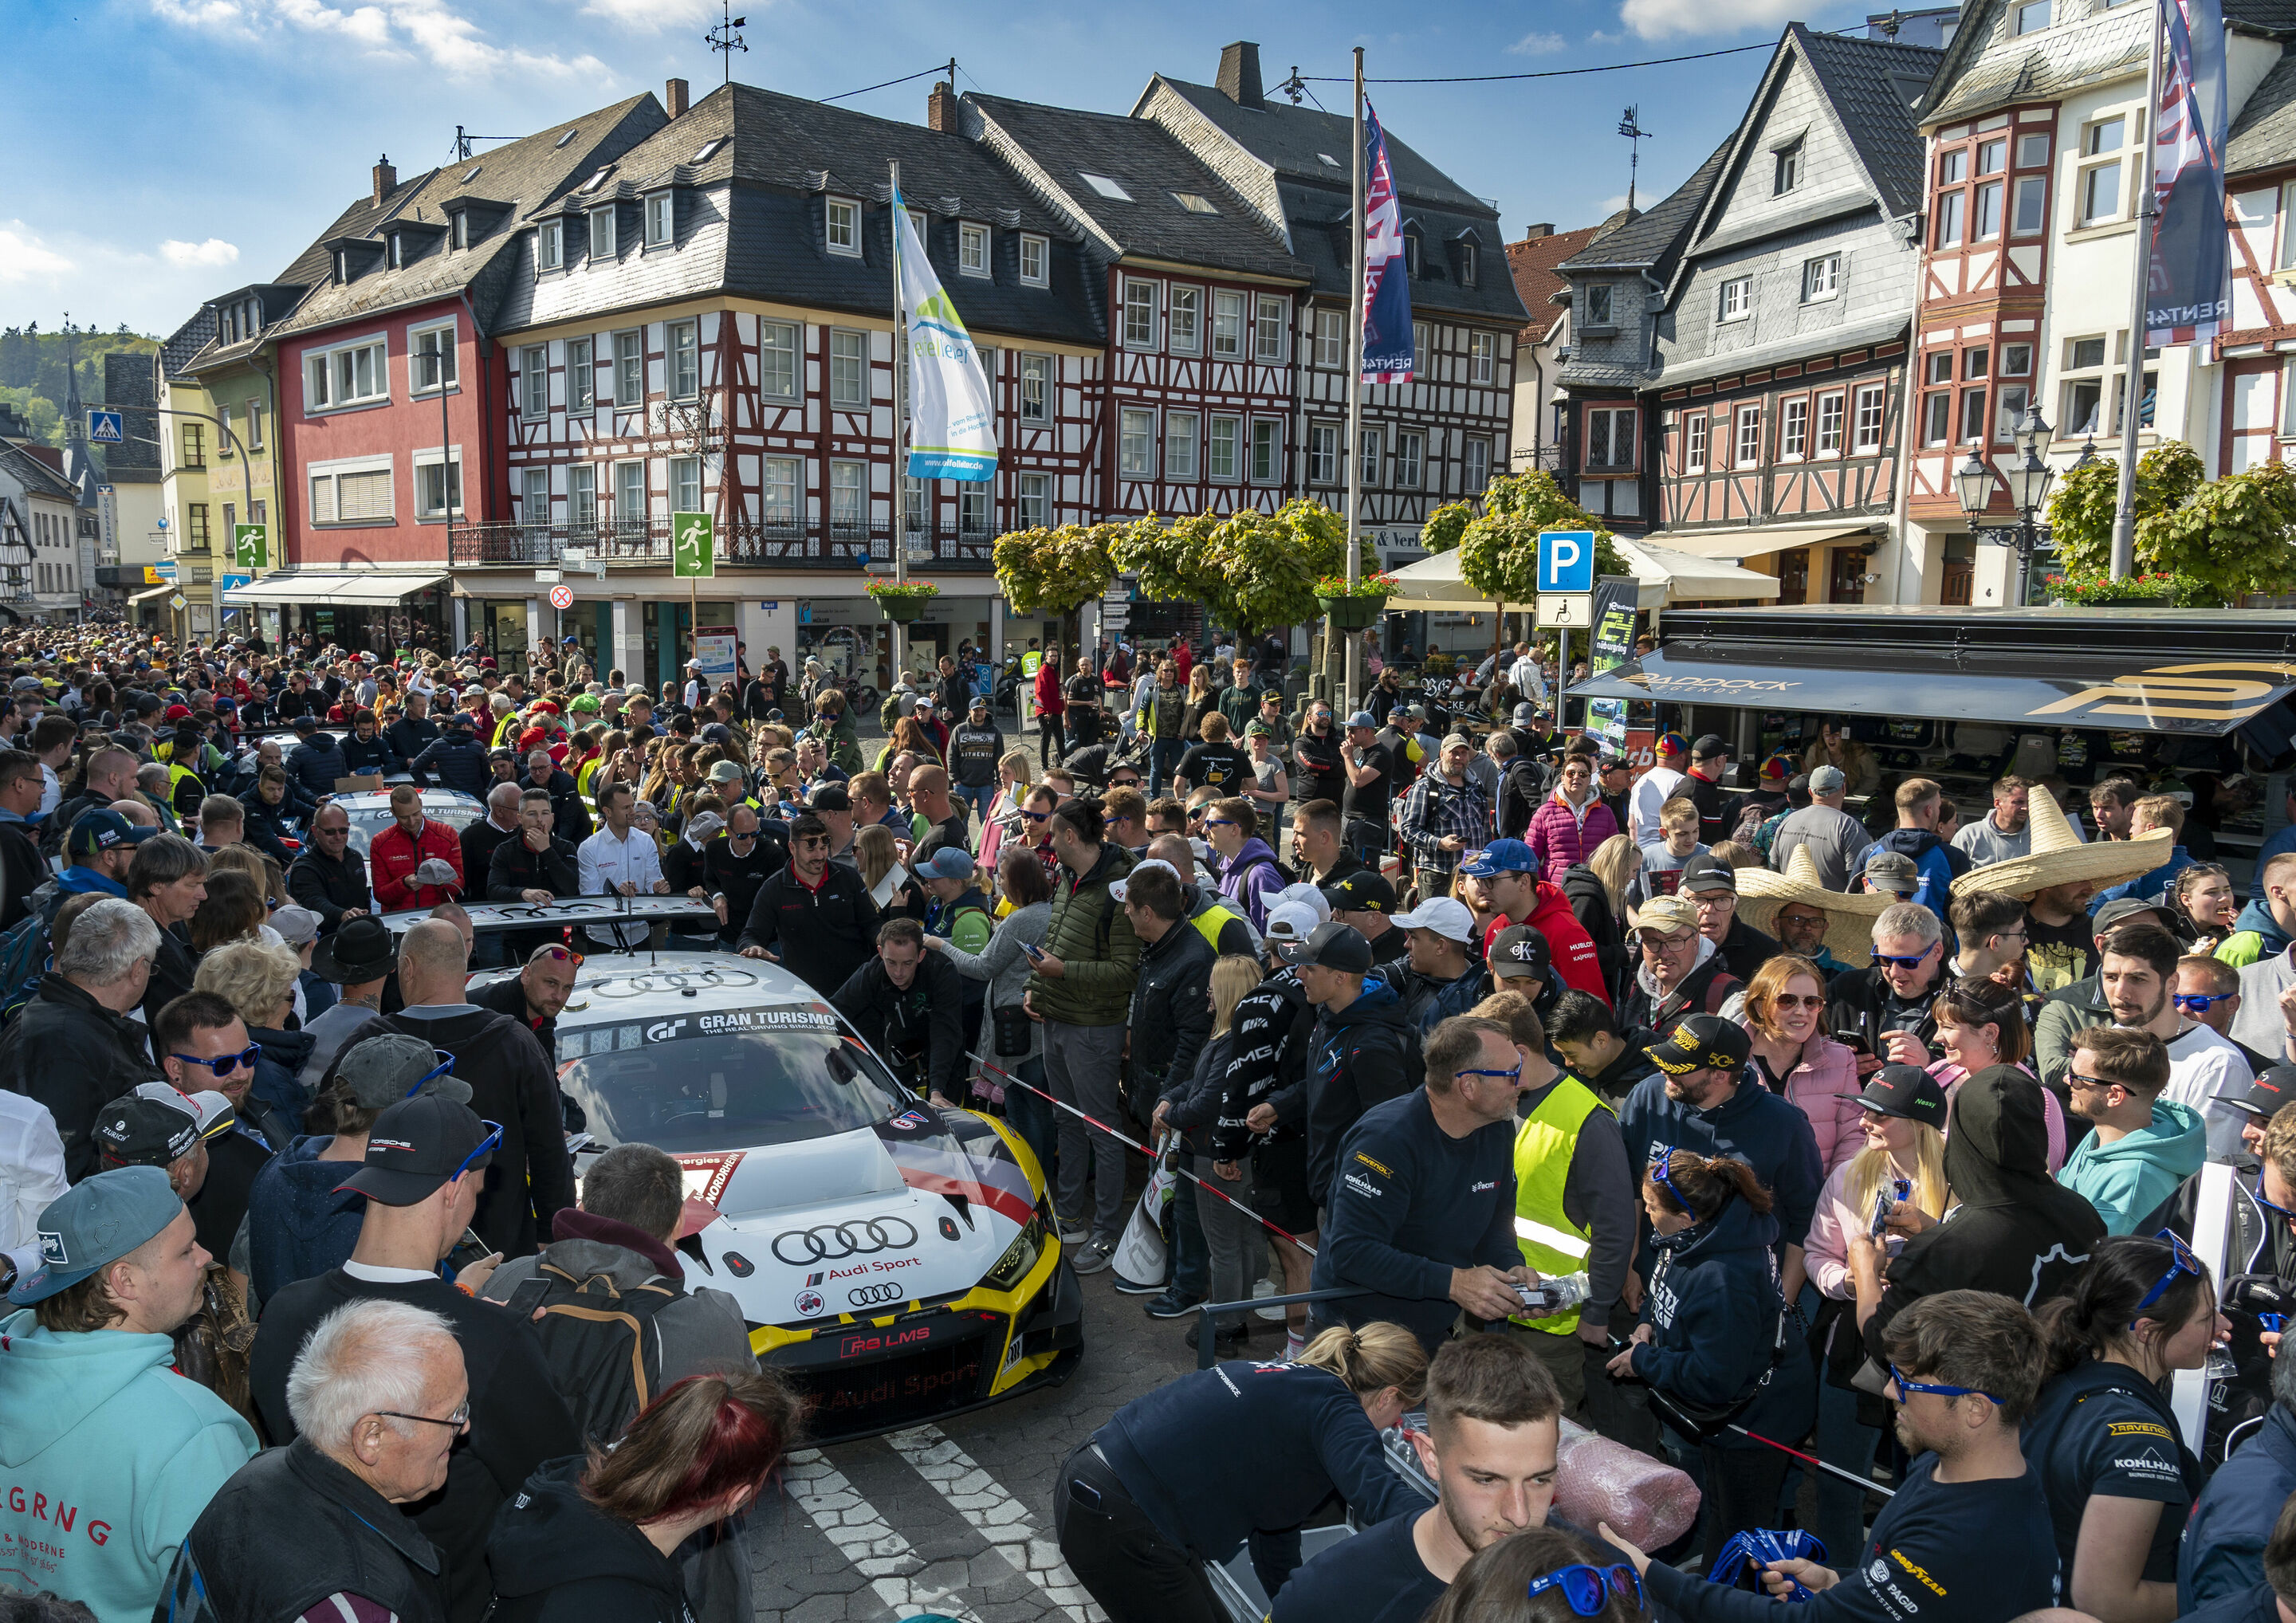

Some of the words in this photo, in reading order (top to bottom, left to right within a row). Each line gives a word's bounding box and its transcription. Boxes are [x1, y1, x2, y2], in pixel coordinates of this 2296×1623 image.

[103, 497, 112, 549] VOLKSBANK
[1378, 531, 1389, 547] &
[1551, 540, 1580, 584] P
[1986, 588, 1992, 598] 6
[1615, 673, 1804, 690] PADDOCK
[1644, 683, 1741, 694] LEGENDS
[438, 808, 482, 818] TURISMO
[1366, 901, 1381, 910] #911
[1569, 941, 1594, 951] HUBLOT
[699, 1014, 751, 1030] GRAN
[756, 1012, 835, 1027] TURISMO
[1226, 1044, 1272, 1079] AMG
[1914, 1098, 1936, 1109] Nessy
[102, 1126, 127, 1142] ZURICH
[370, 1138, 411, 1148] PORSCHE
[677, 1157, 721, 1166] nergies
[1358, 1154, 1387, 1175] RAVENOL
[705, 1153, 740, 1206] NORDRHEIN
[1345, 1173, 1382, 1196] KOHLHAAS
[829, 1261, 868, 1280] Audi
[871, 1257, 922, 1275] Sport
[850, 1337, 881, 1354] R8
[886, 1326, 930, 1347] LMS
[830, 1381, 895, 1410] Audi
[904, 1361, 978, 1397] Sport
[2117, 1425, 2169, 1436] RAVENOL
[0, 1486, 112, 1546] GRNG
[4, 1533, 13, 1542] &
[18, 1534, 65, 1558] MODERNE
[1890, 1549, 1947, 1597] GOODYEAR
[1870, 1588, 1903, 1621] SYSTEMS
[1887, 1583, 1918, 1613] PAGID
